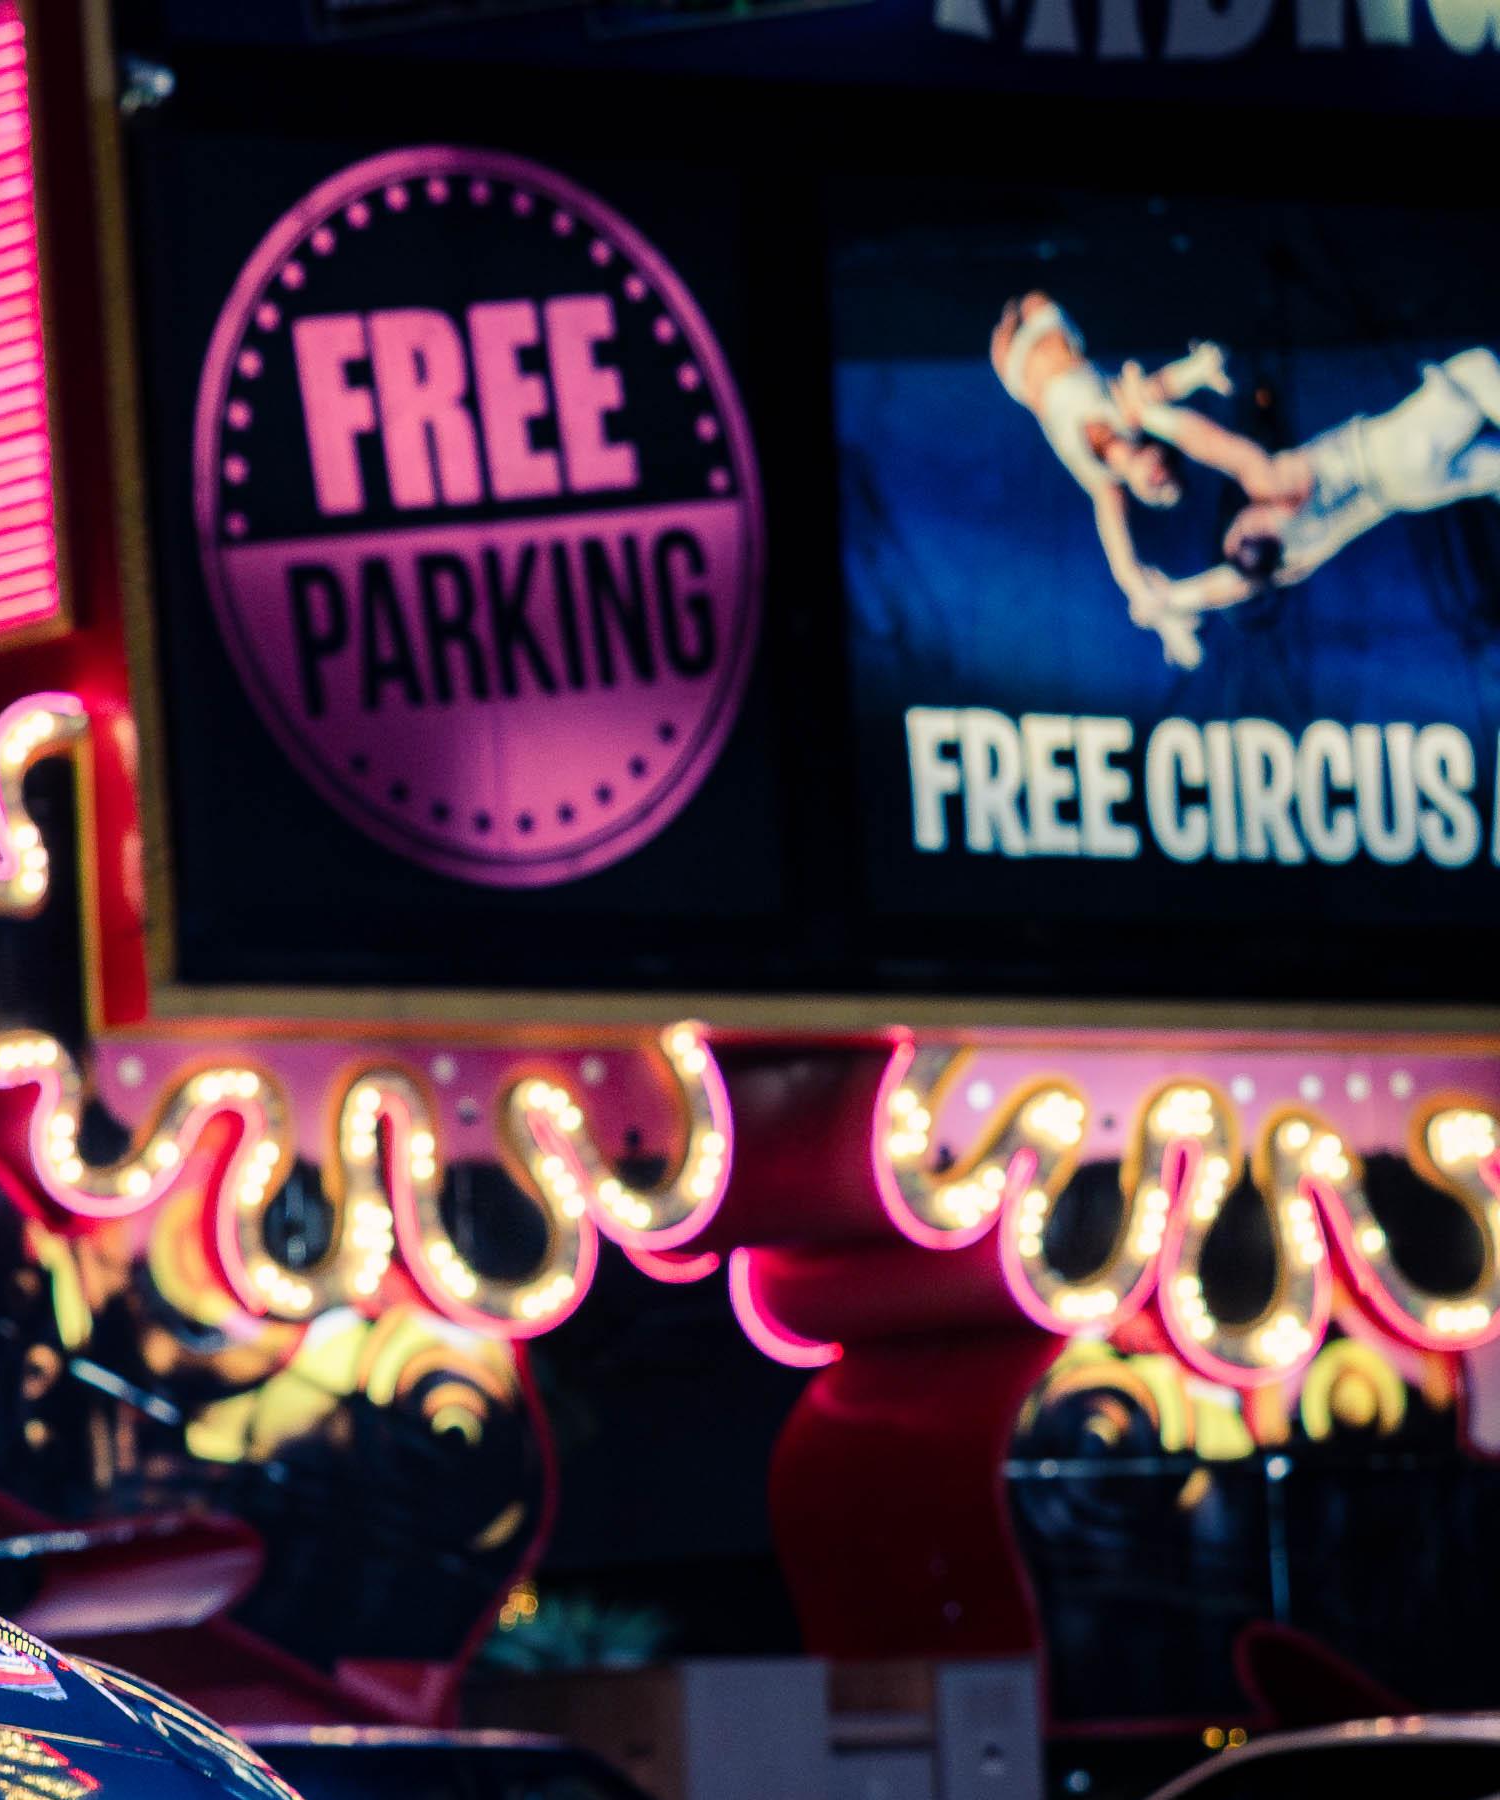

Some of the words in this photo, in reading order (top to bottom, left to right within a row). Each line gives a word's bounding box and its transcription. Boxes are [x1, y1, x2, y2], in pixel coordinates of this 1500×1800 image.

[292, 295, 640, 517] FREE
[286, 528, 717, 719] PARKING
[905, 707, 1141, 858] FREE
[1145, 717, 1483, 867] CIRCUS
